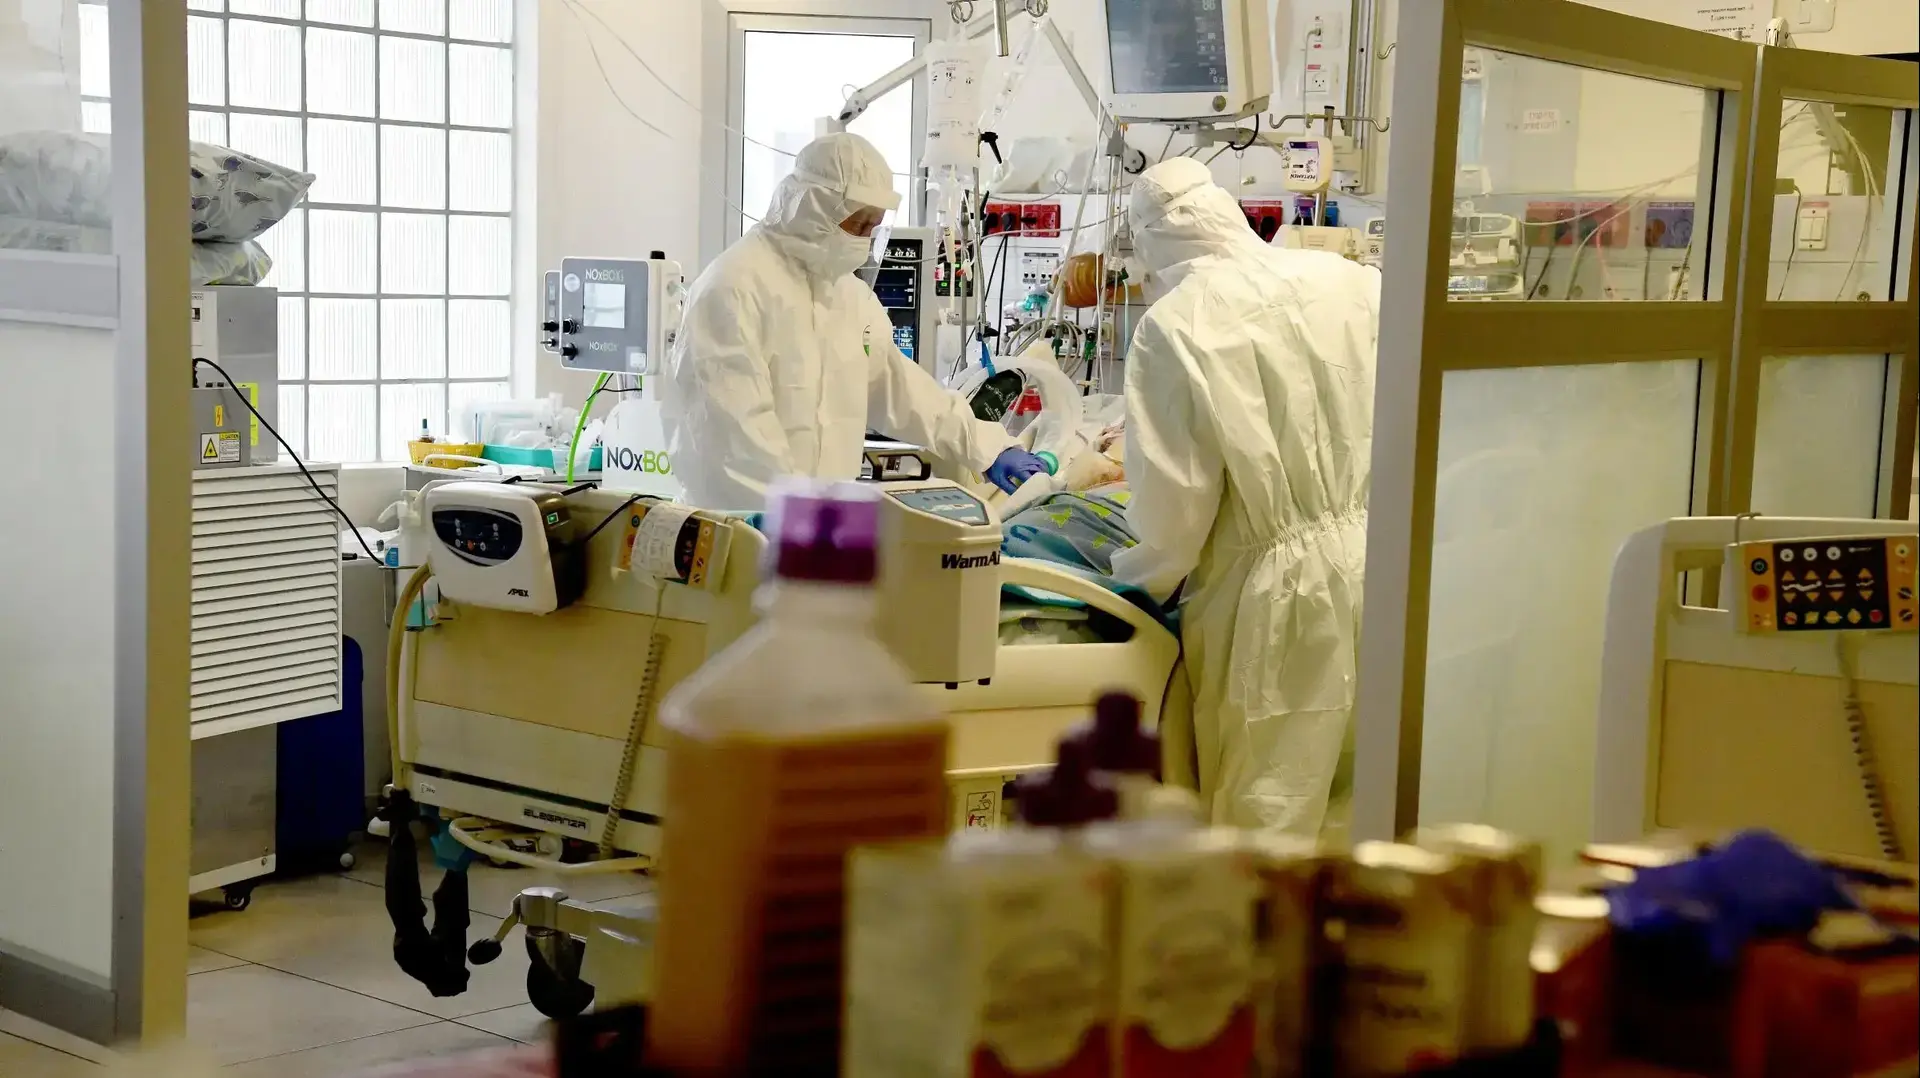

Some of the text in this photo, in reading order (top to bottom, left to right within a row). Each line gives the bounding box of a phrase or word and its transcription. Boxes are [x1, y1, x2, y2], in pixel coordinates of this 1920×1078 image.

[607, 446, 671, 475] NOxBO
[941, 550, 1001, 569] WarmAi
[507, 588, 530, 598] APEX
[523, 808, 587, 830] ELEGANZA
